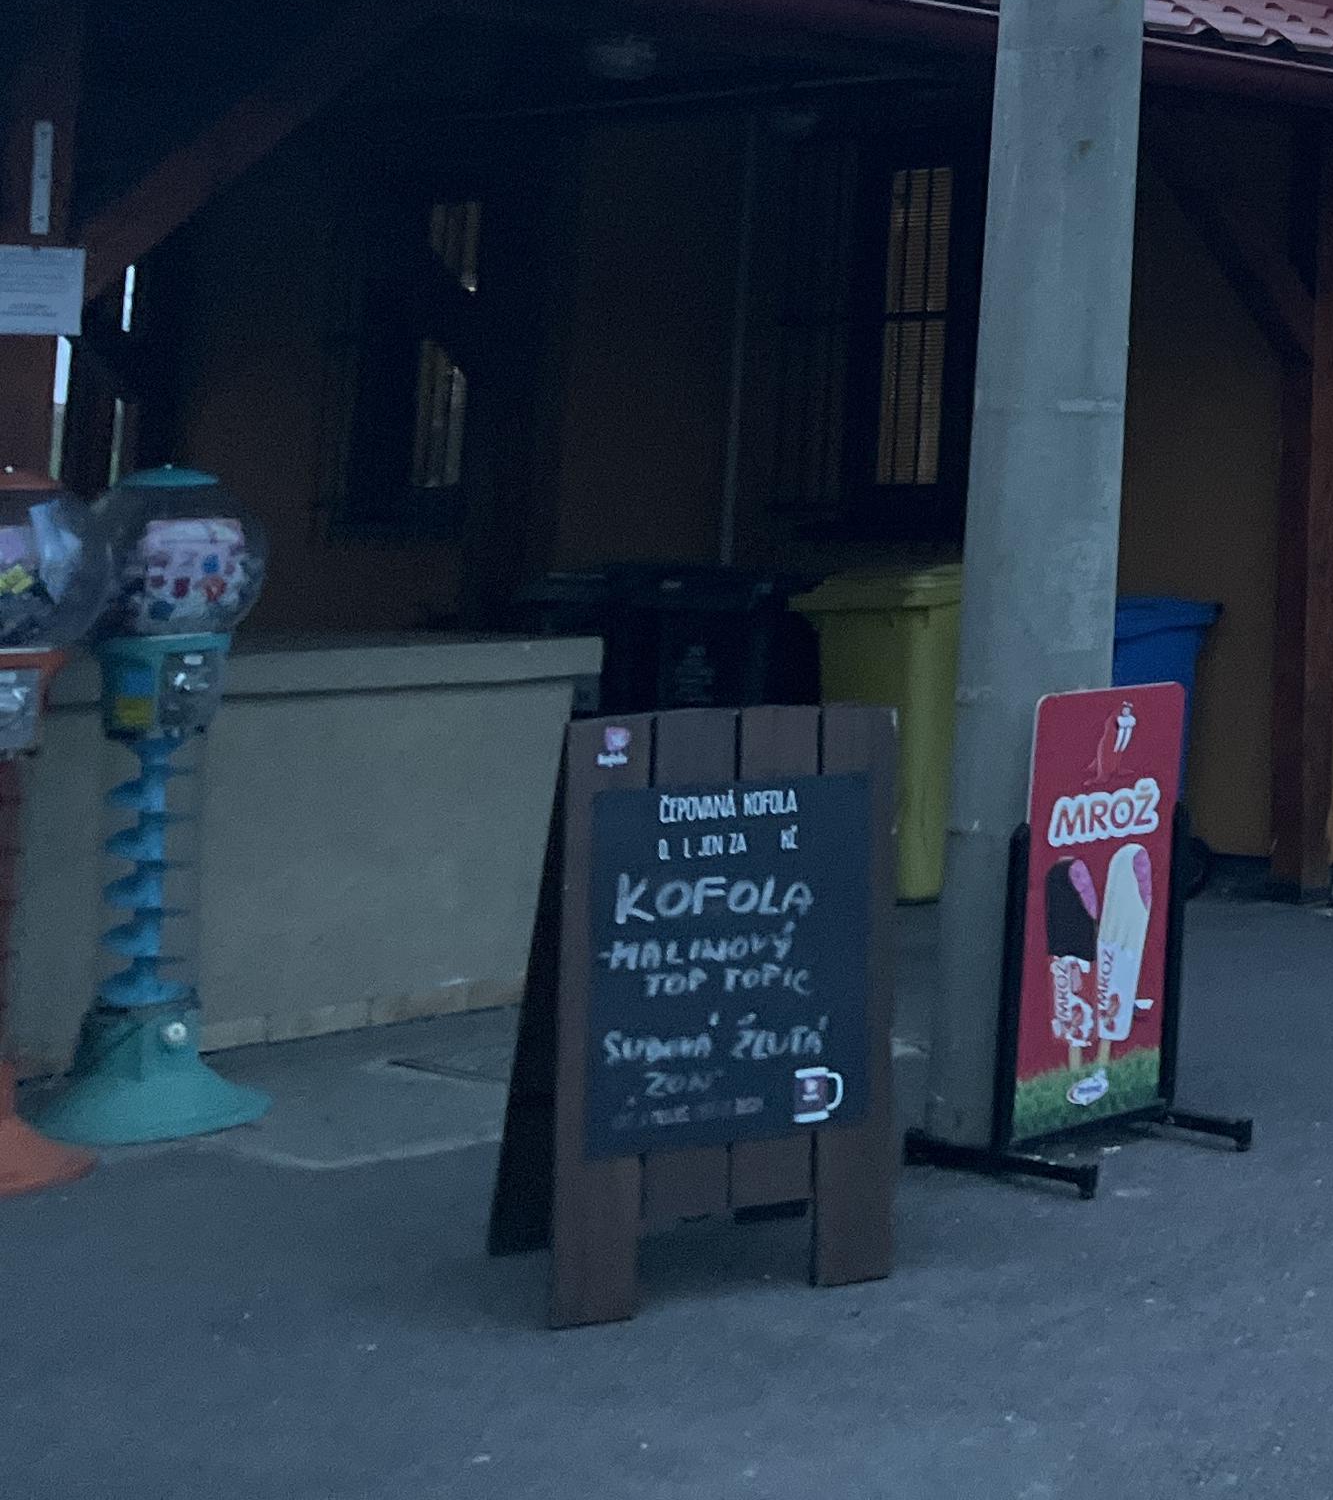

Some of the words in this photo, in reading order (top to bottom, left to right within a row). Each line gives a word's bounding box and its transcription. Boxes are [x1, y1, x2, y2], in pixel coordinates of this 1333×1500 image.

[658, 788, 737, 824] ČEPOVANÁ
[742, 787, 799, 817] KOFOLA
[1054, 784, 1156, 839] MROŽ
[728, 832, 748, 855] ZA
[614, 872, 815, 925] KOFOLA
[645, 970, 708, 997] TOP
